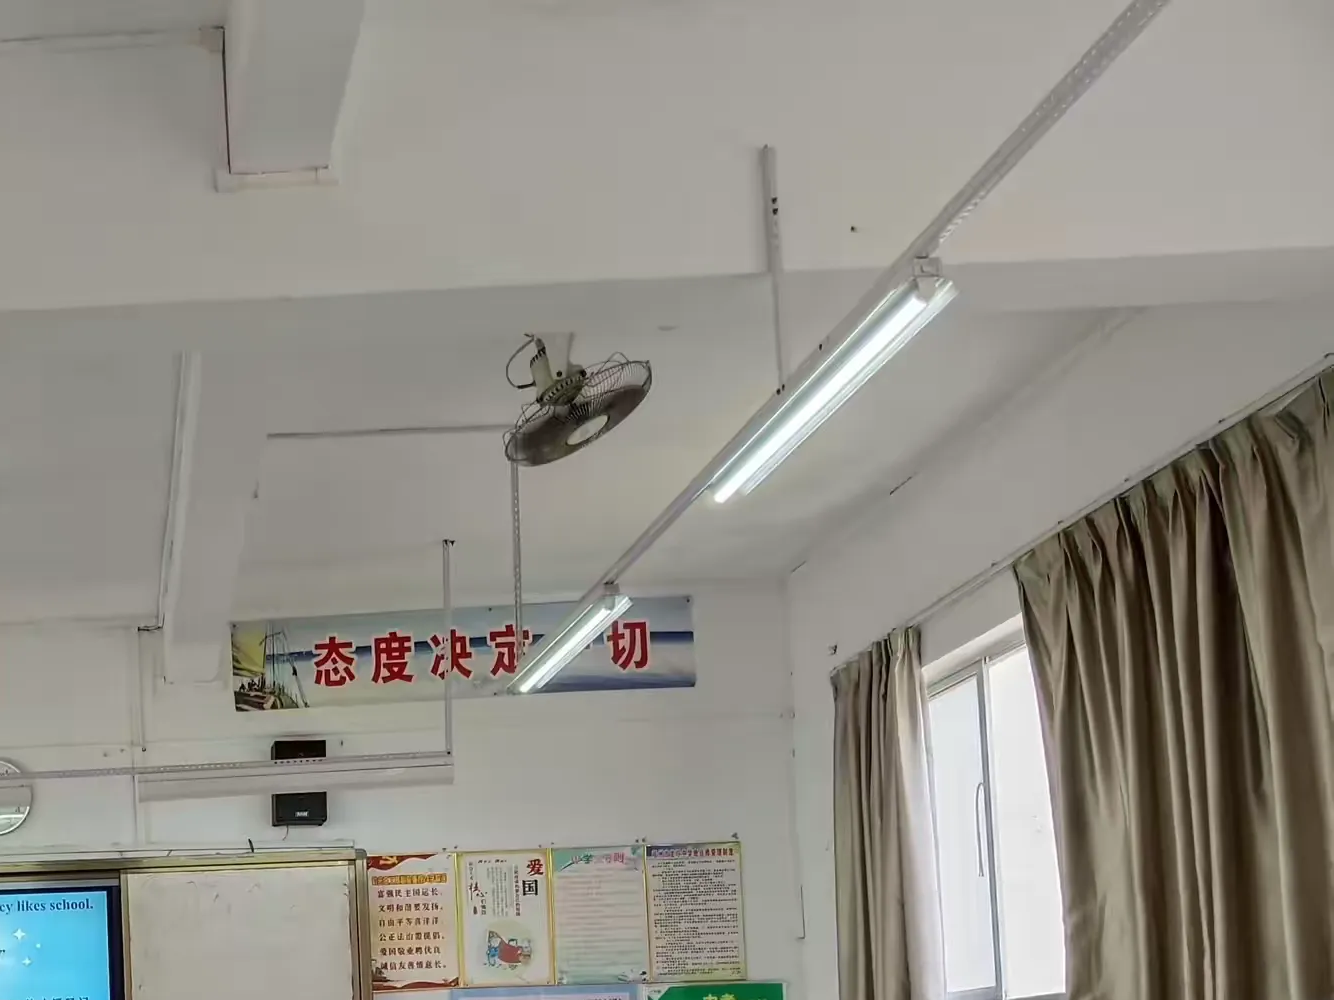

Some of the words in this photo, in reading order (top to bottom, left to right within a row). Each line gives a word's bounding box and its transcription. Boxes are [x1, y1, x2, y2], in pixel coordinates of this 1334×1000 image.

[313, 620, 650, 686] 态度决定切
[17, 900, 46, 912] likes
[49, 897, 94, 911] school.
